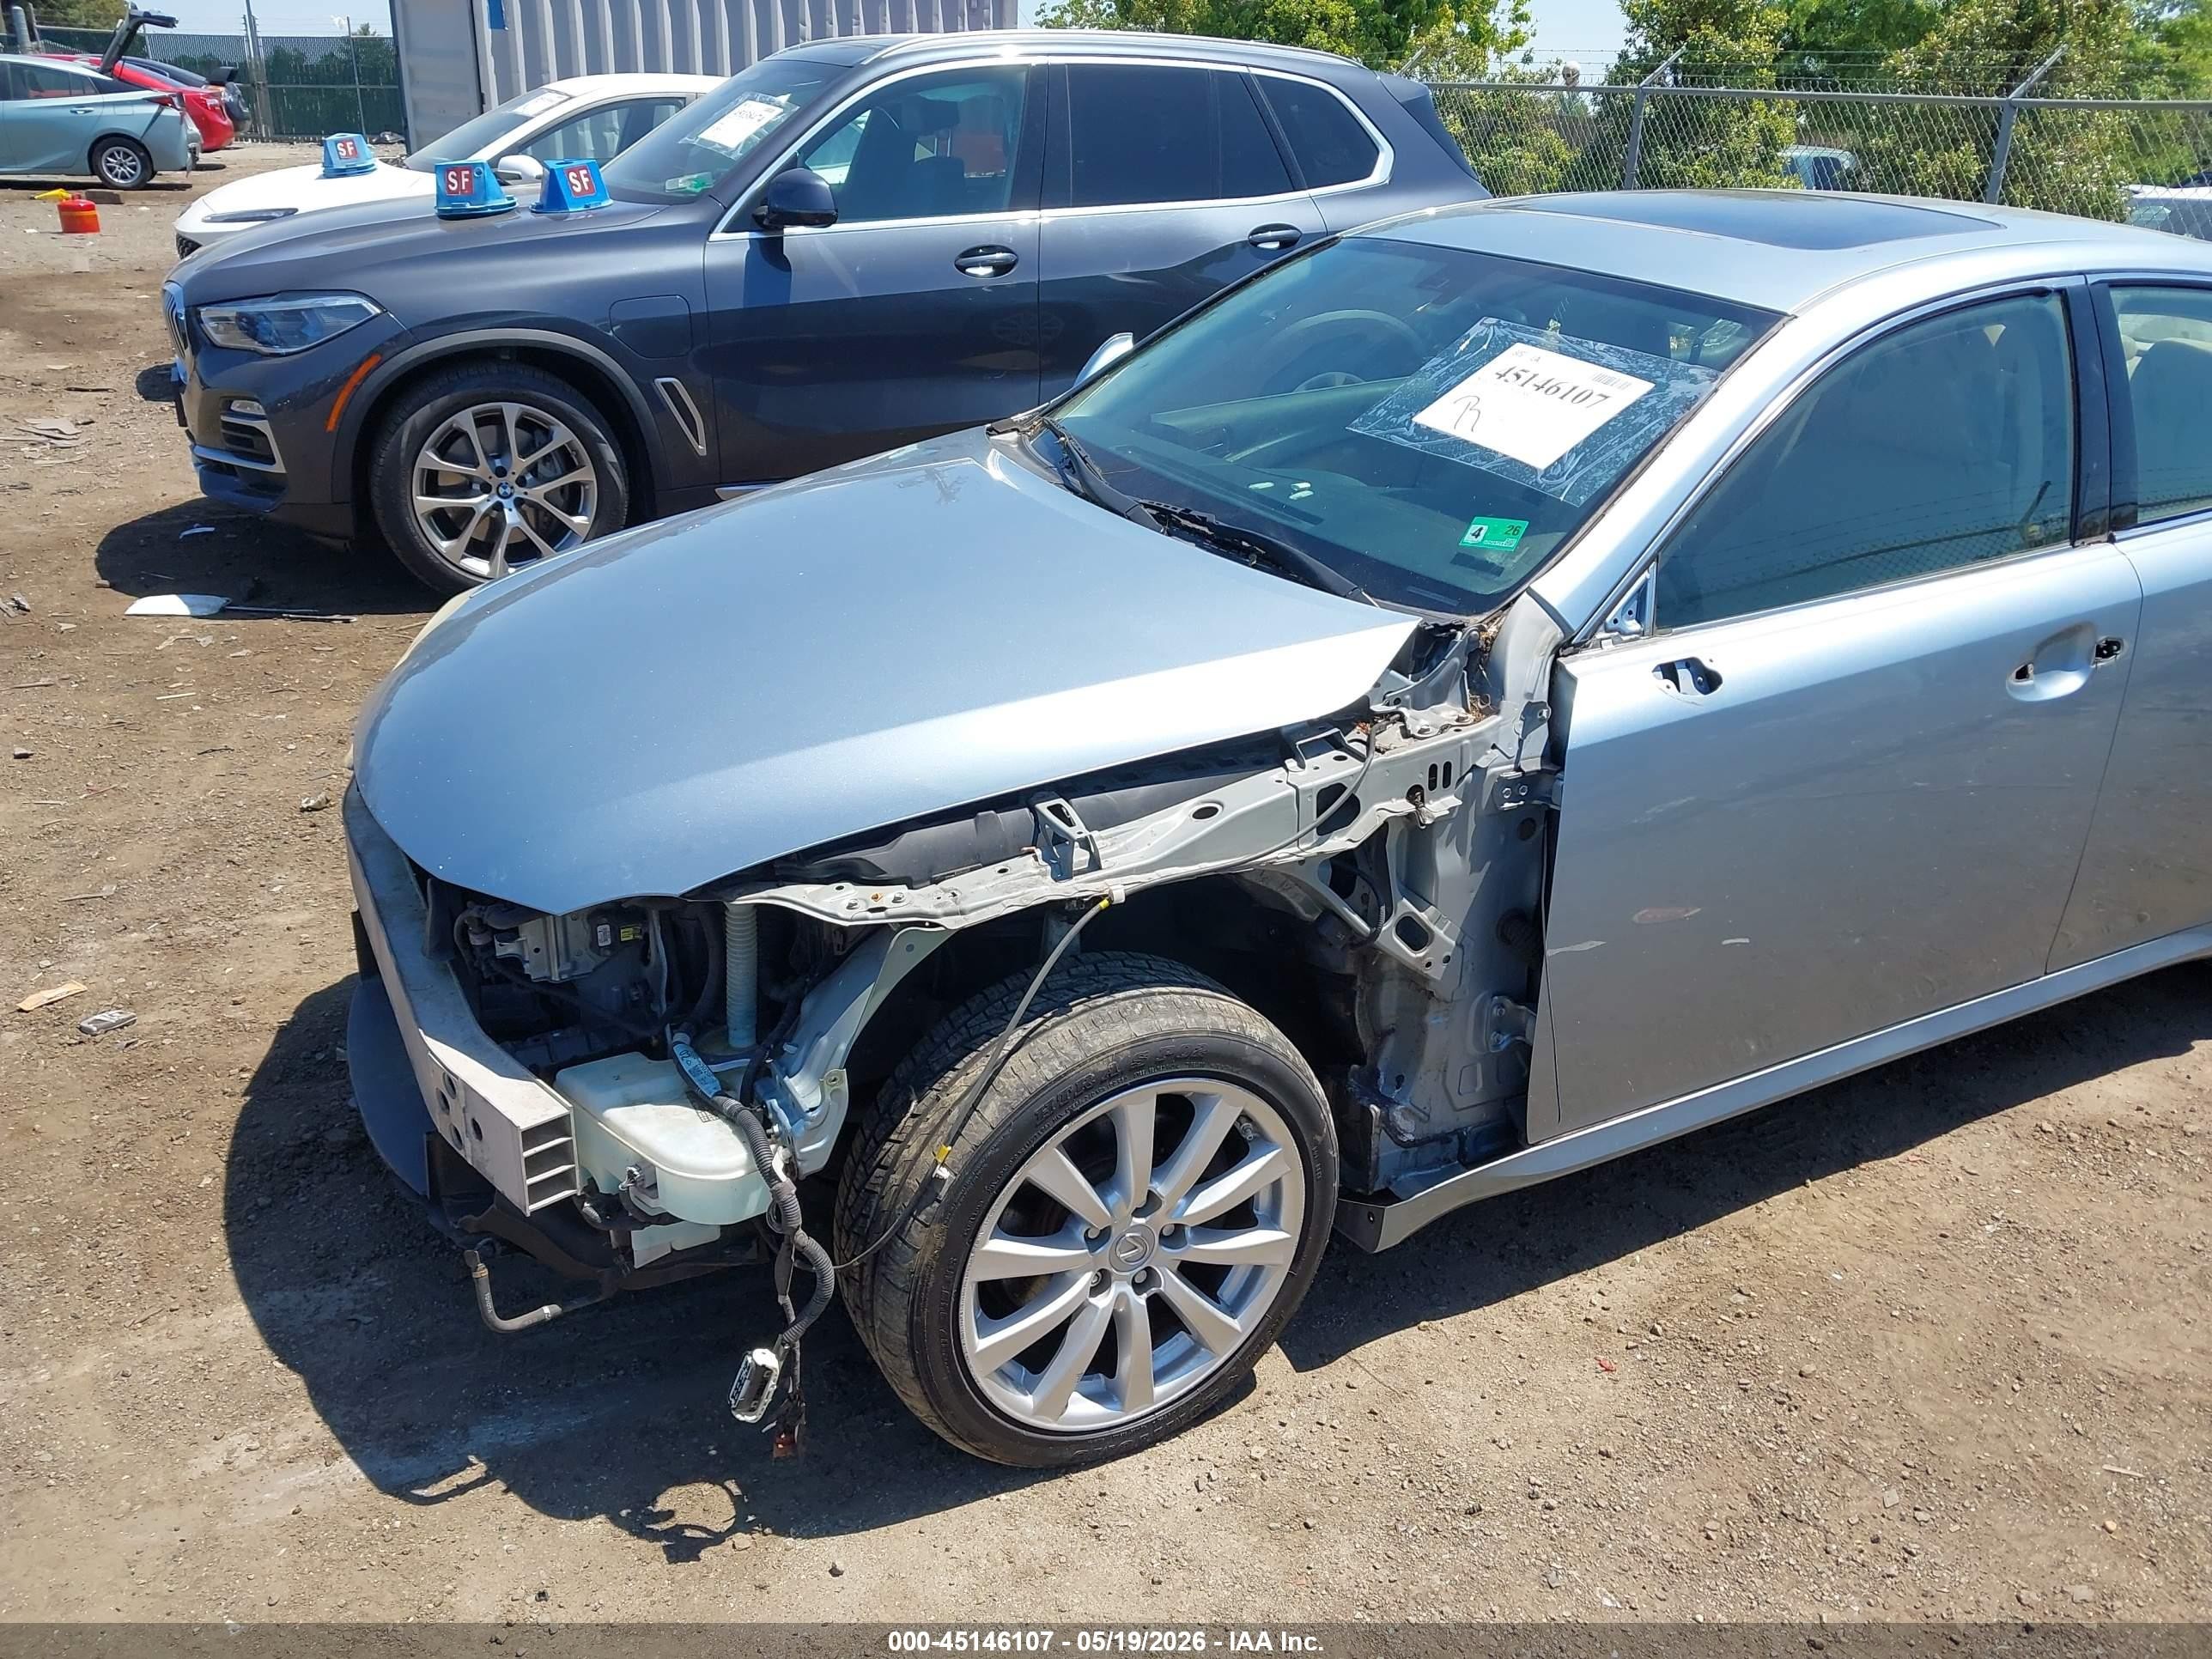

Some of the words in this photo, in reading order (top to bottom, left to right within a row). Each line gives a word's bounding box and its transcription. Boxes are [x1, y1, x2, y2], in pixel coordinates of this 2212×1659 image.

[337, 142, 354, 156] SF
[447, 170, 470, 191] SF
[568, 169, 590, 193] SF
[1495, 366, 1612, 408] 45146107
[1470, 526, 1484, 539] 4
[1504, 525, 1522, 537] 26
